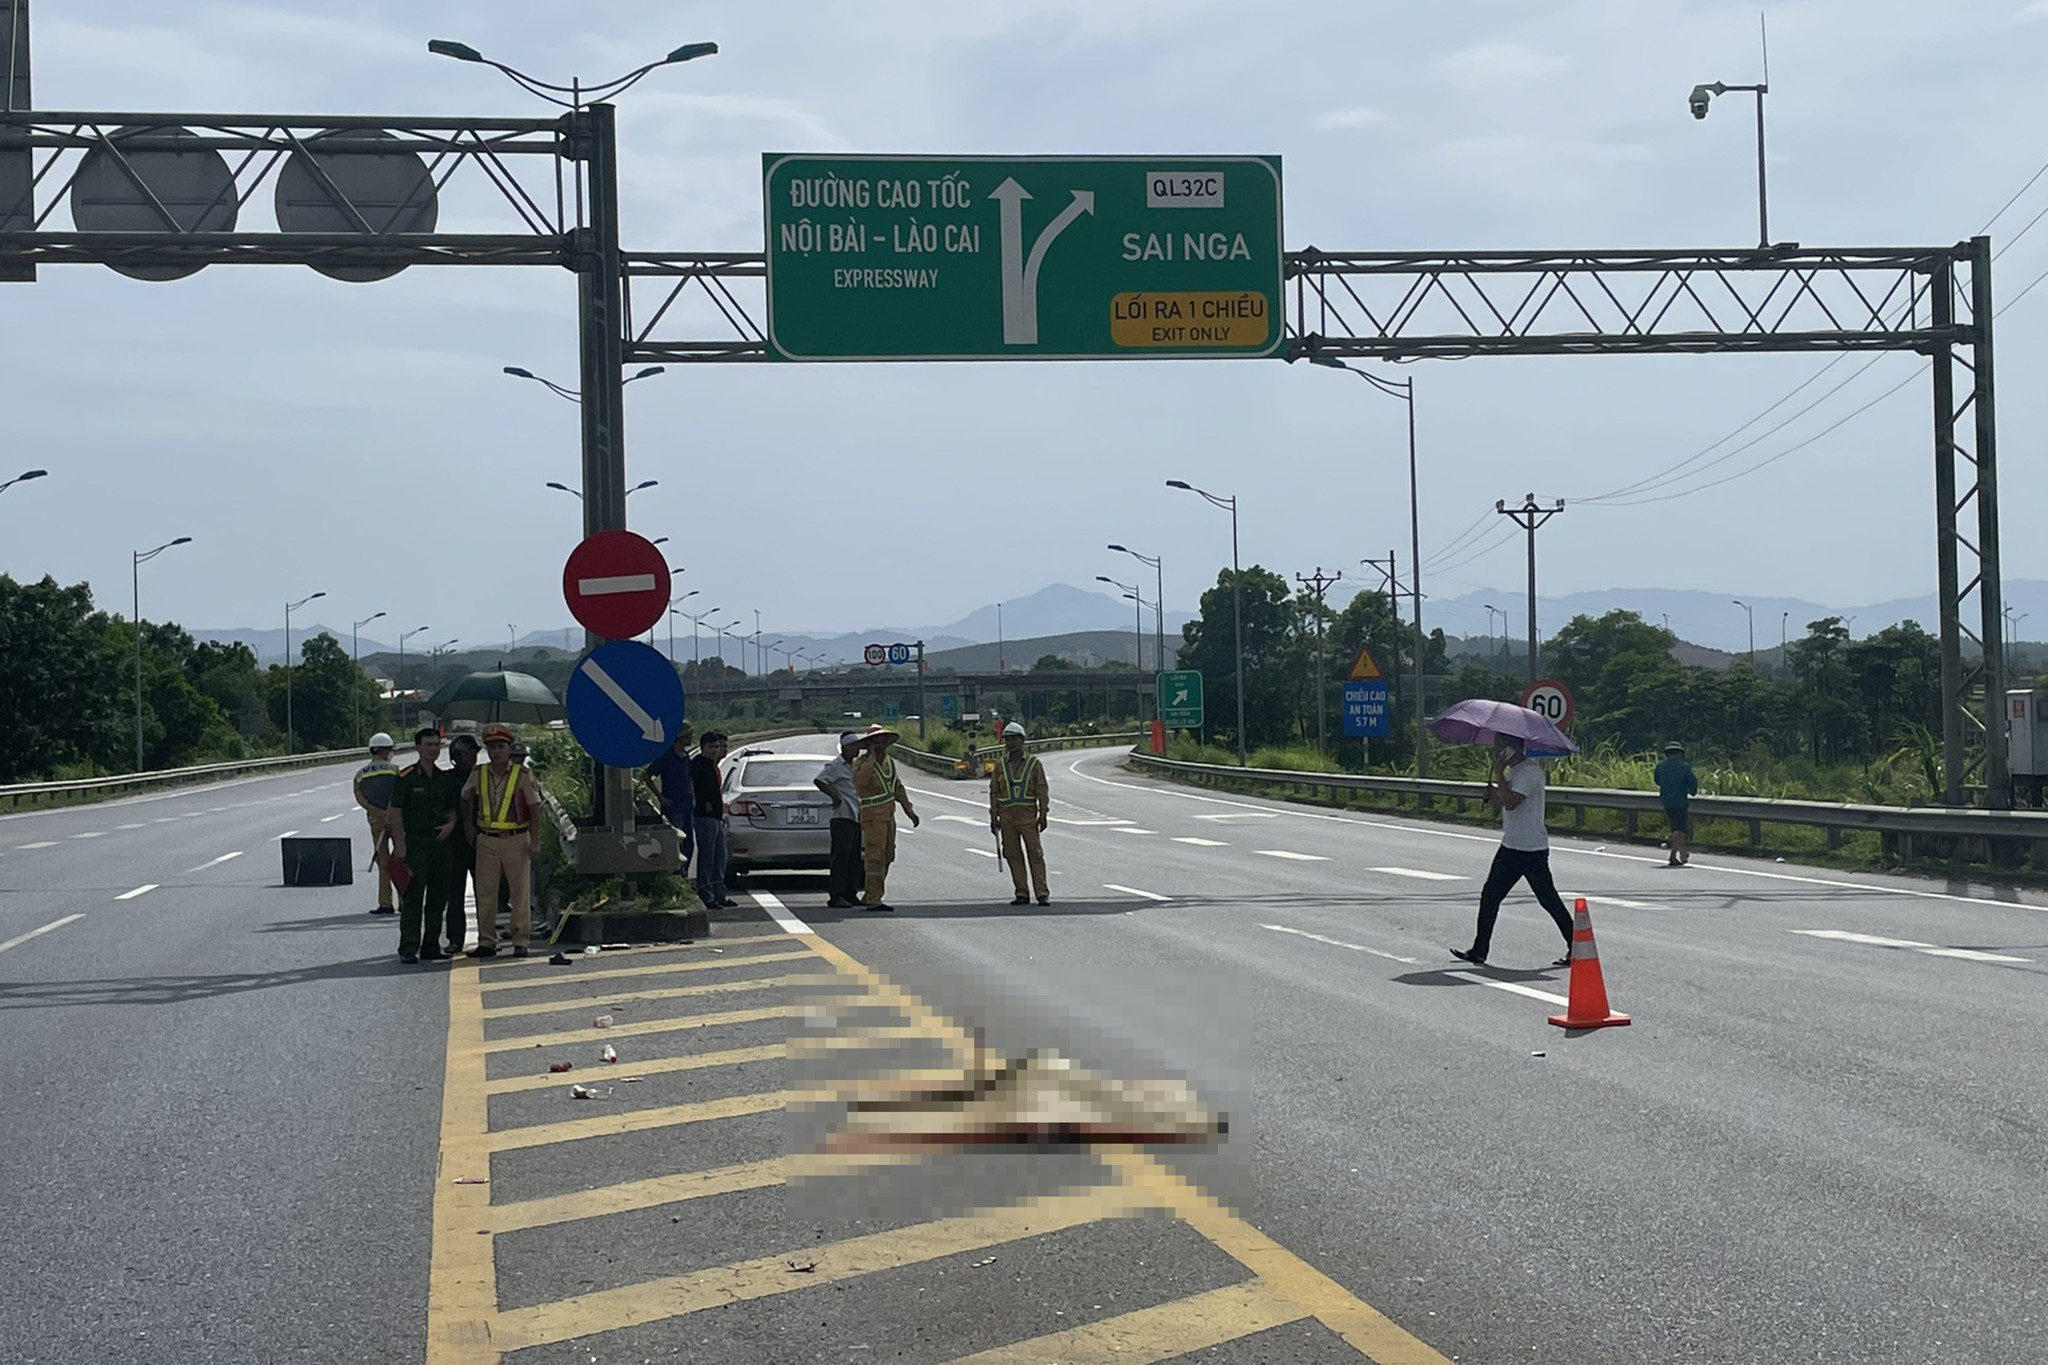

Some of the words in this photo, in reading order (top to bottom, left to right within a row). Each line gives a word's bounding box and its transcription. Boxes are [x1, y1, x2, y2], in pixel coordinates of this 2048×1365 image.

[790, 171, 870, 208] ĐƯỜNG
[877, 180, 921, 208] CAO
[928, 170, 971, 208] TỐC
[1153, 178, 1217, 197] QL32C
[781, 218, 822, 257] NỘI
[829, 216, 867, 253] BÀI
[894, 216, 938, 253] LÀO
[945, 224, 980, 253] CAI
[1122, 232, 1173, 261] SAI
[1184, 232, 1251, 260] NGA
[834, 269, 939, 288] EXPRESSWAY
[1115, 294, 1148, 319] LỐI
[1154, 300, 1183, 319] RA
[1189, 300, 1196, 318] 1
[1202, 293, 1264, 318] CHIỀU
[1152, 327, 1186, 341] EXIT
[1190, 327, 1230, 341] ONLY
[868, 650, 883, 660] 100
[891, 646, 907, 660] 60
[1370, 690, 1386, 702] CAO
[1349, 704, 1361, 715] AN
[1533, 695, 1561, 719] 60
[1369, 716, 1377, 727] M
